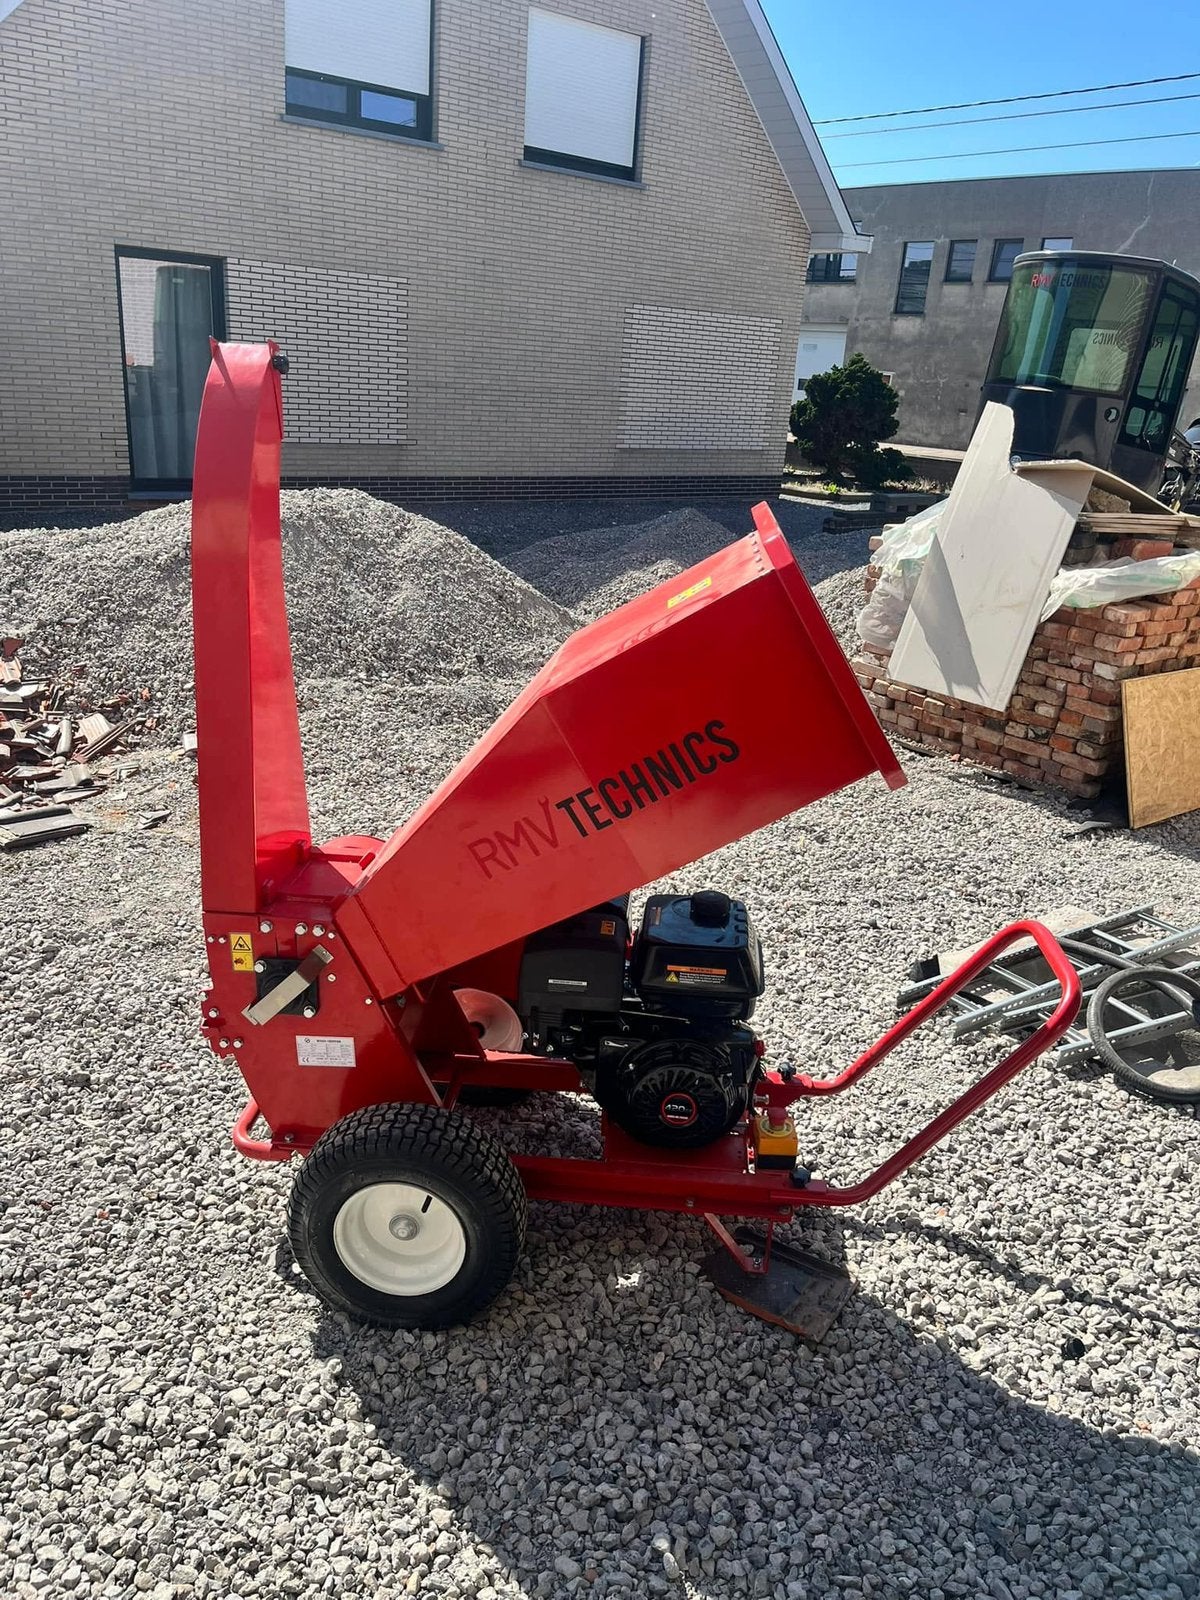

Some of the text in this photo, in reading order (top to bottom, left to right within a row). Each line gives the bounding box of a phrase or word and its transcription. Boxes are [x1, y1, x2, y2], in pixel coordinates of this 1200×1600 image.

[1031, 272, 1105, 289] RMV TECHNICS
[467, 720, 740, 879] RMV TECHNICS
